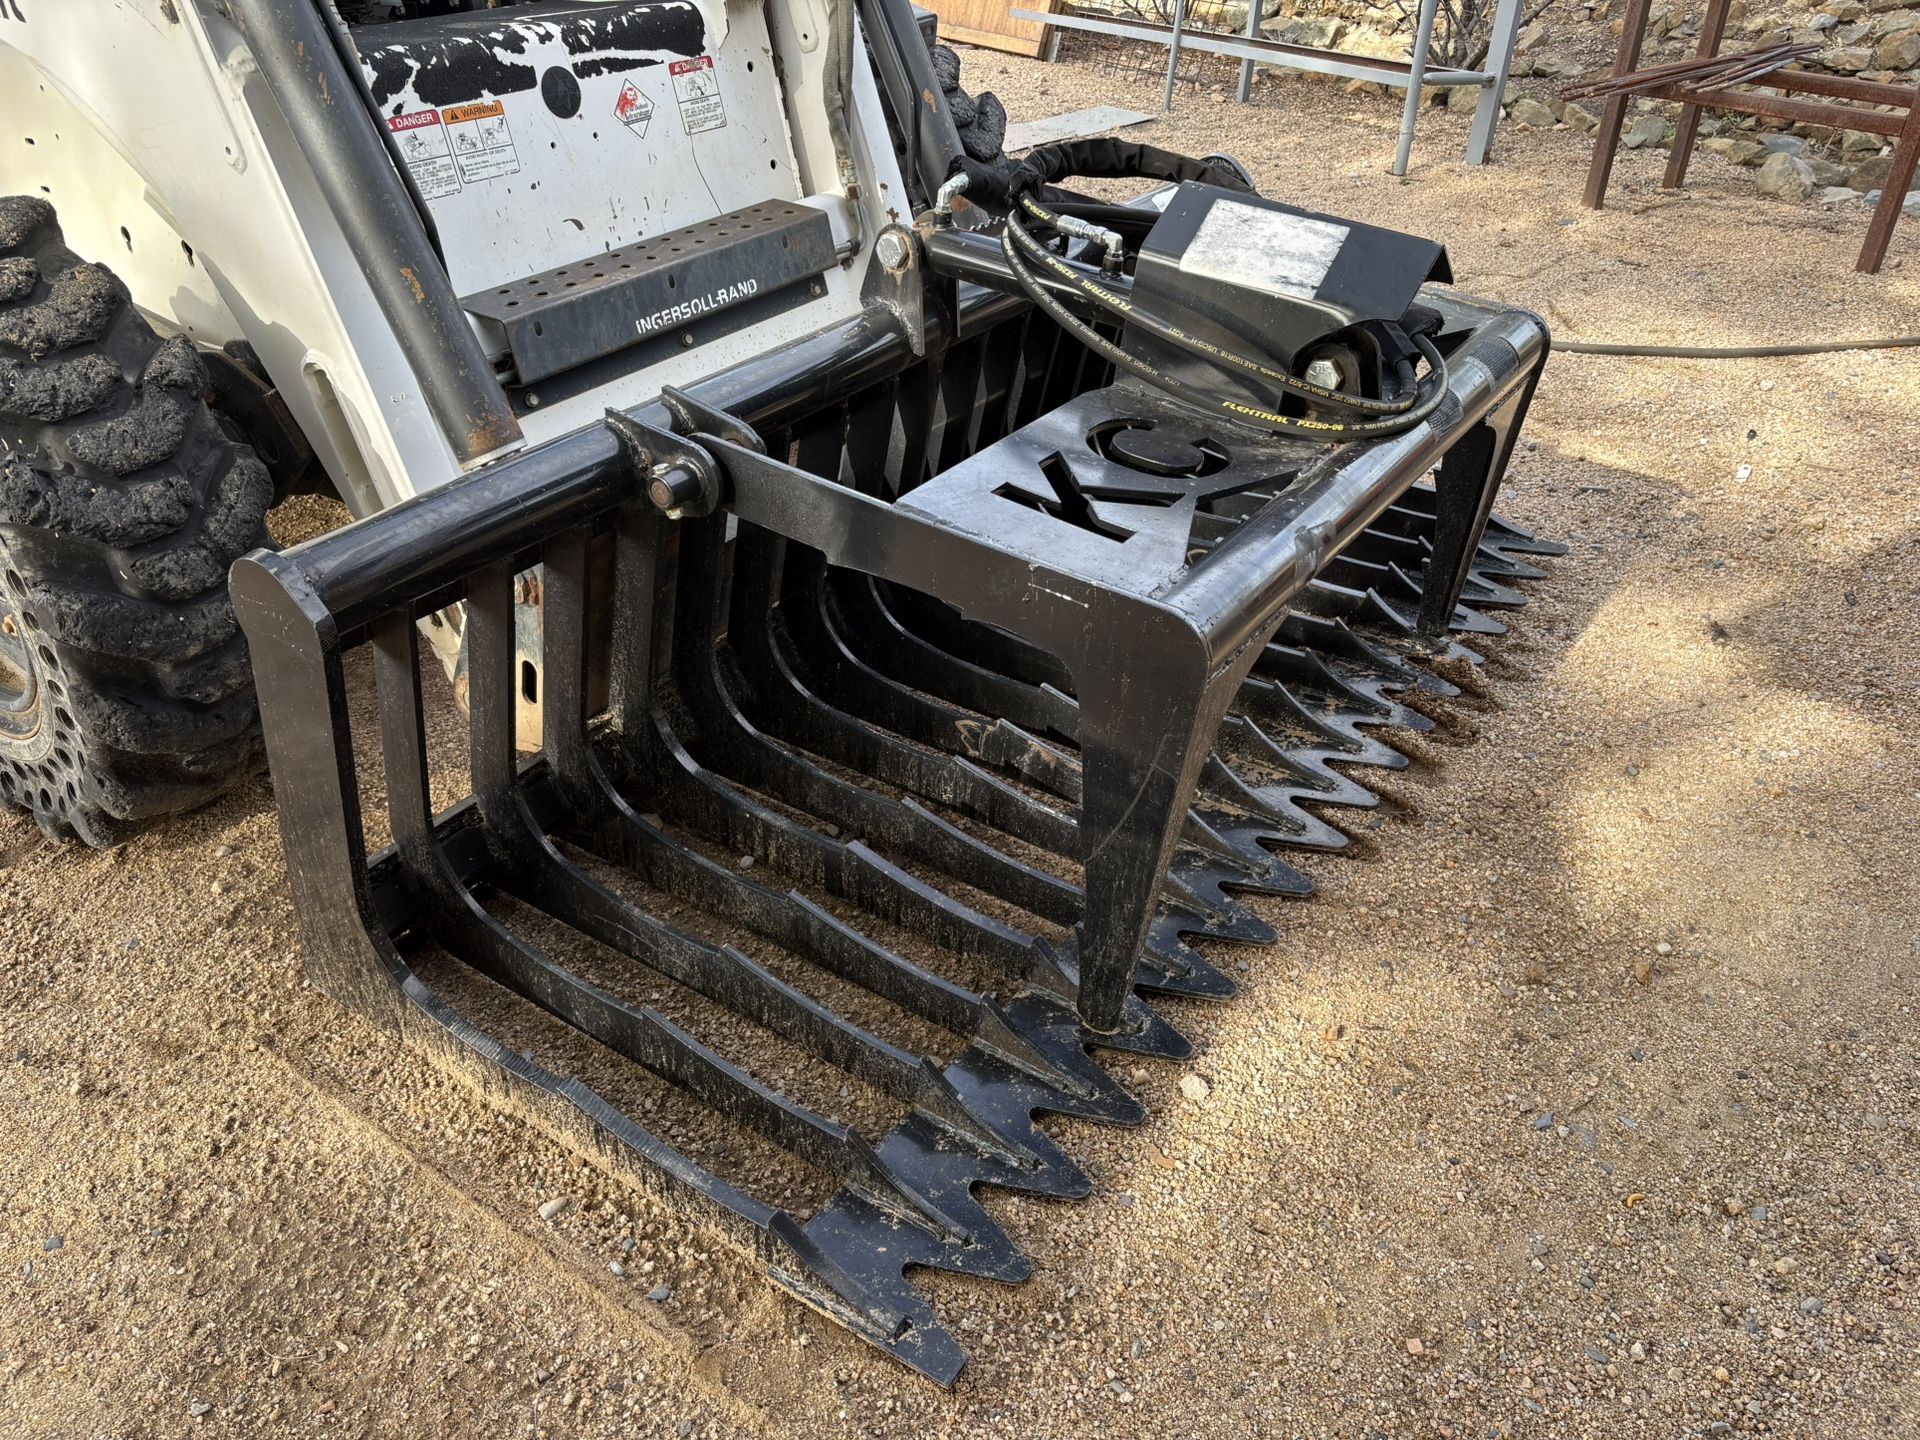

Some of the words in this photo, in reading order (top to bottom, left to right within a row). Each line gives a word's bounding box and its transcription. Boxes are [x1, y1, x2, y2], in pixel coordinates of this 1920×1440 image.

[461, 104, 498, 117] WARNING
[396, 114, 433, 127] DANGER
[636, 279, 758, 335] INGERSOLL-RAND
[1190, 336, 1218, 353] USCG-H
[1259, 366, 1286, 381] Exceeds
[1221, 400, 1289, 424] FLEXTRAL
[1296, 419, 1344, 431] PX250-06
